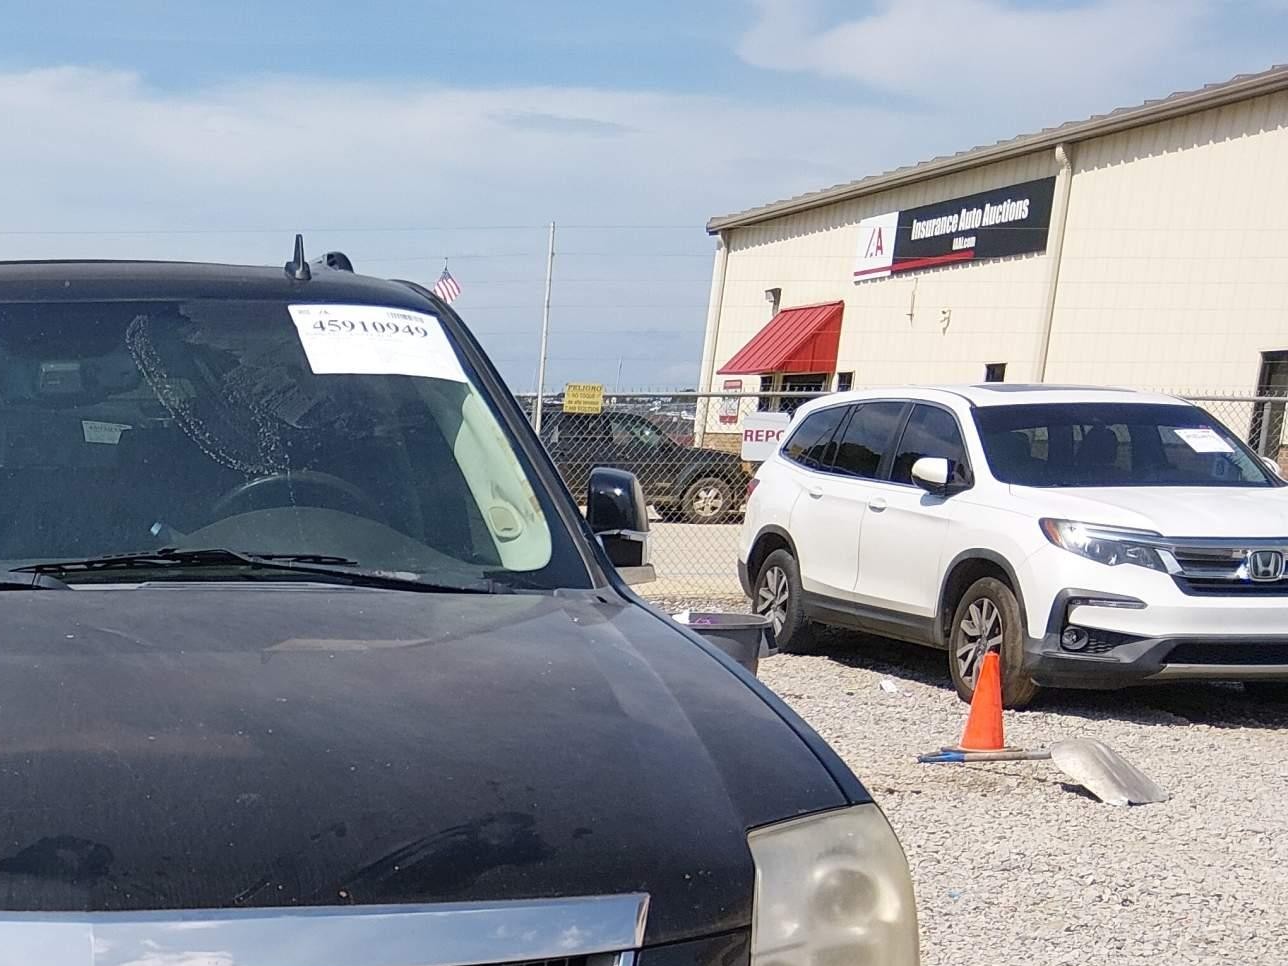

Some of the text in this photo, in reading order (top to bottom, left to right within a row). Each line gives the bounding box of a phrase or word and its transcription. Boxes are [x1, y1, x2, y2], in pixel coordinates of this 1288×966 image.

[911, 198, 1029, 240] Insurance Auto Auctions
[312, 319, 428, 337] 45910949
